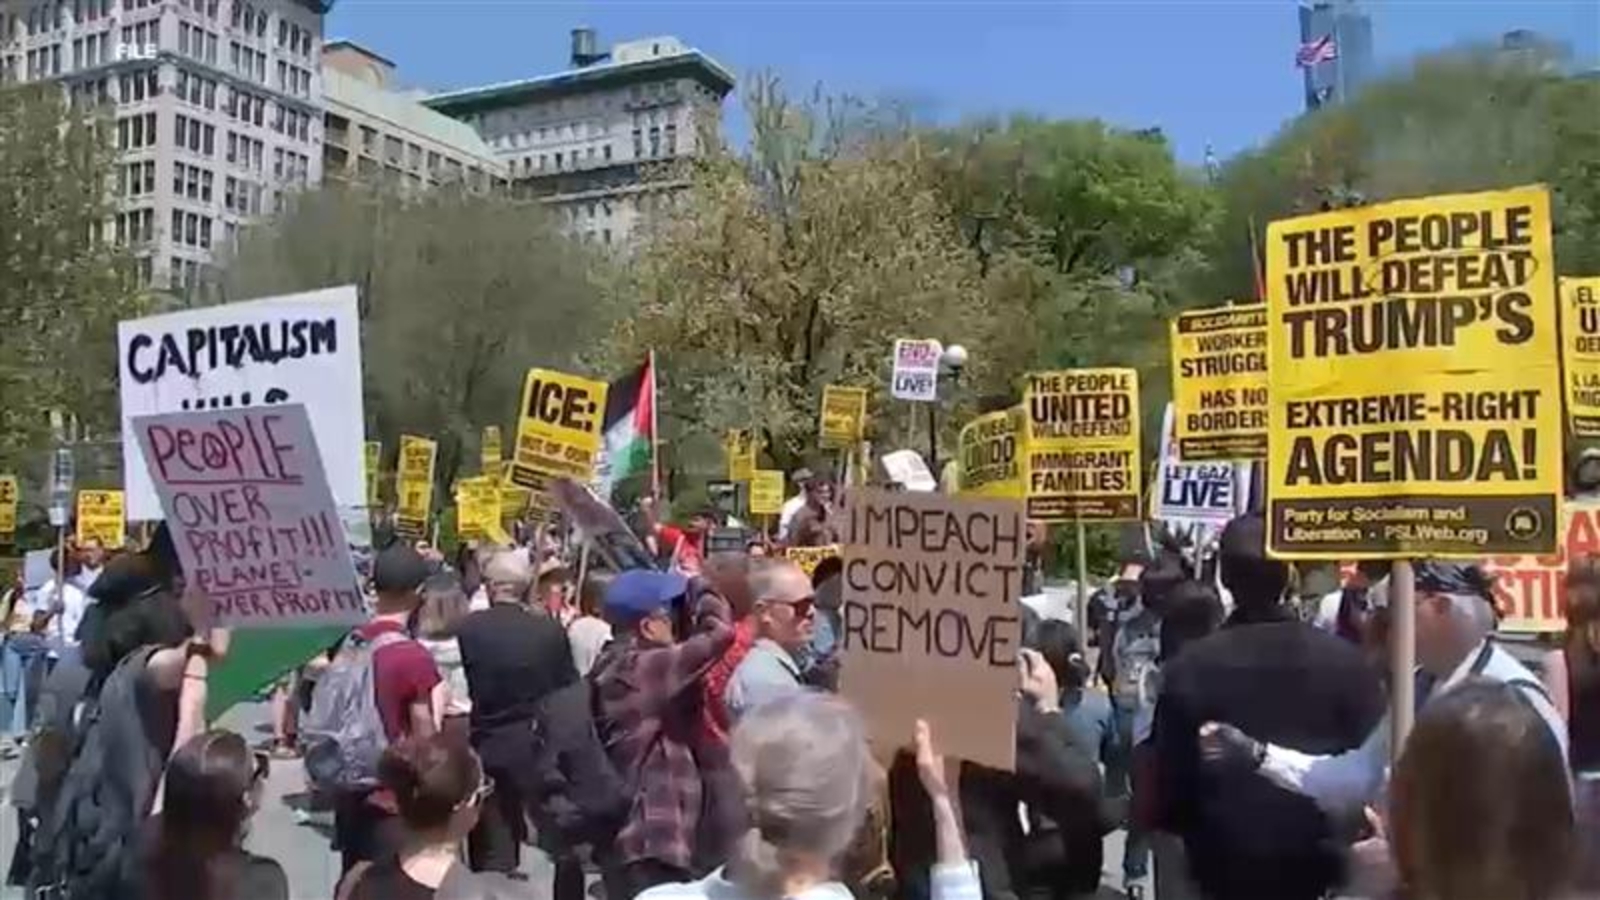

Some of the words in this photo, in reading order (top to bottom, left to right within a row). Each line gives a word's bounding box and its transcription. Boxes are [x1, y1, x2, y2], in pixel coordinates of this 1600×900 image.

[1282, 226, 1356, 268] THE
[1368, 206, 1533, 257] PEOPLE
[1286, 266, 1376, 307] WILL
[1382, 251, 1532, 295] DEFEAT
[1282, 292, 1535, 359] TRUMP'S
[128, 318, 338, 384] CAPITALISM
[1031, 376, 1061, 393] THE
[1065, 374, 1130, 392] PEOPLE
[1200, 389, 1236, 409] HAS
[1243, 387, 1268, 407] NO
[527, 379, 596, 432] ICE:
[1030, 394, 1131, 423] UNITED
[1187, 410, 1268, 432] BORDER
[1286, 389, 1541, 429] EXTREME-RIGHT
[1032, 423, 1067, 438] WILL
[1070, 422, 1131, 438] DEFEND
[1031, 451, 1134, 470] IMMIGRANT
[1284, 428, 1538, 486] AGENDA!
[1031, 471, 1132, 492] FAMILIES!
[173, 485, 271, 528] OVER
[1284, 508, 1324, 525] Party
[1327, 506, 1349, 521] for
[1353, 506, 1430, 522] Socialism
[1432, 507, 1464, 521] and
[850, 504, 1019, 560] IMPEACH
[1284, 527, 1361, 542] Liberation
[1384, 524, 1488, 545] PSLWeb.org
[847, 558, 1019, 603] CONVICT
[843, 601, 1018, 667] REMOVE
